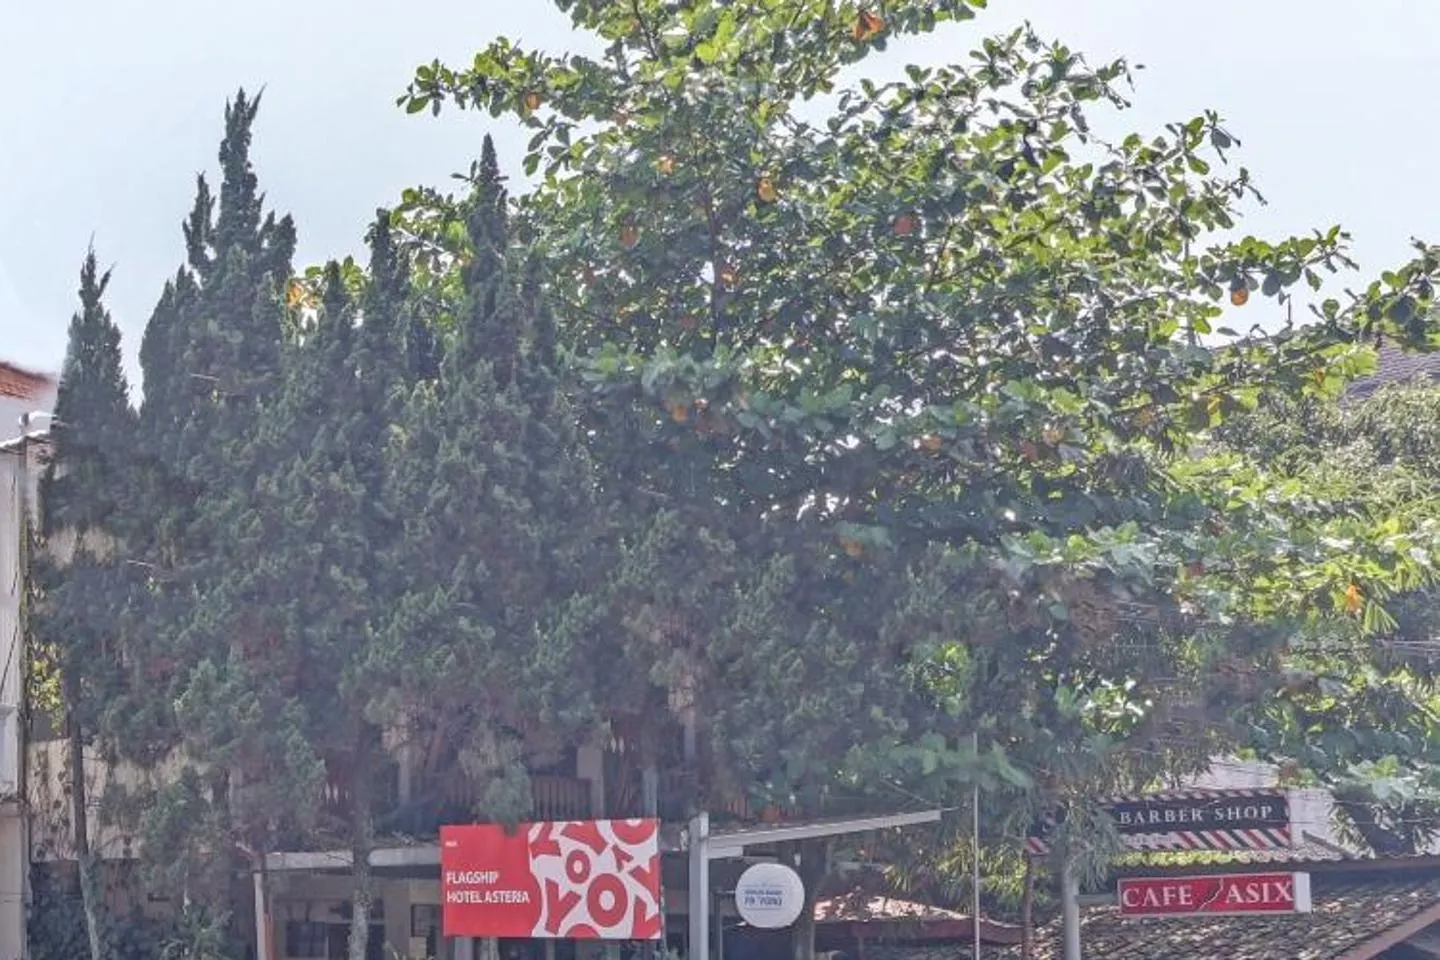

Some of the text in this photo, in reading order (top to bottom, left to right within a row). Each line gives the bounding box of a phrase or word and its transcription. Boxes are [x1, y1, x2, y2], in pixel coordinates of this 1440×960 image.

[1120, 805, 1273, 825] BARBER SHOP
[446, 871, 499, 885] FLAGSHIP
[446, 889, 531, 904] HOTEL ASTERIA
[1122, 881, 1294, 907] CAFE ASIX
